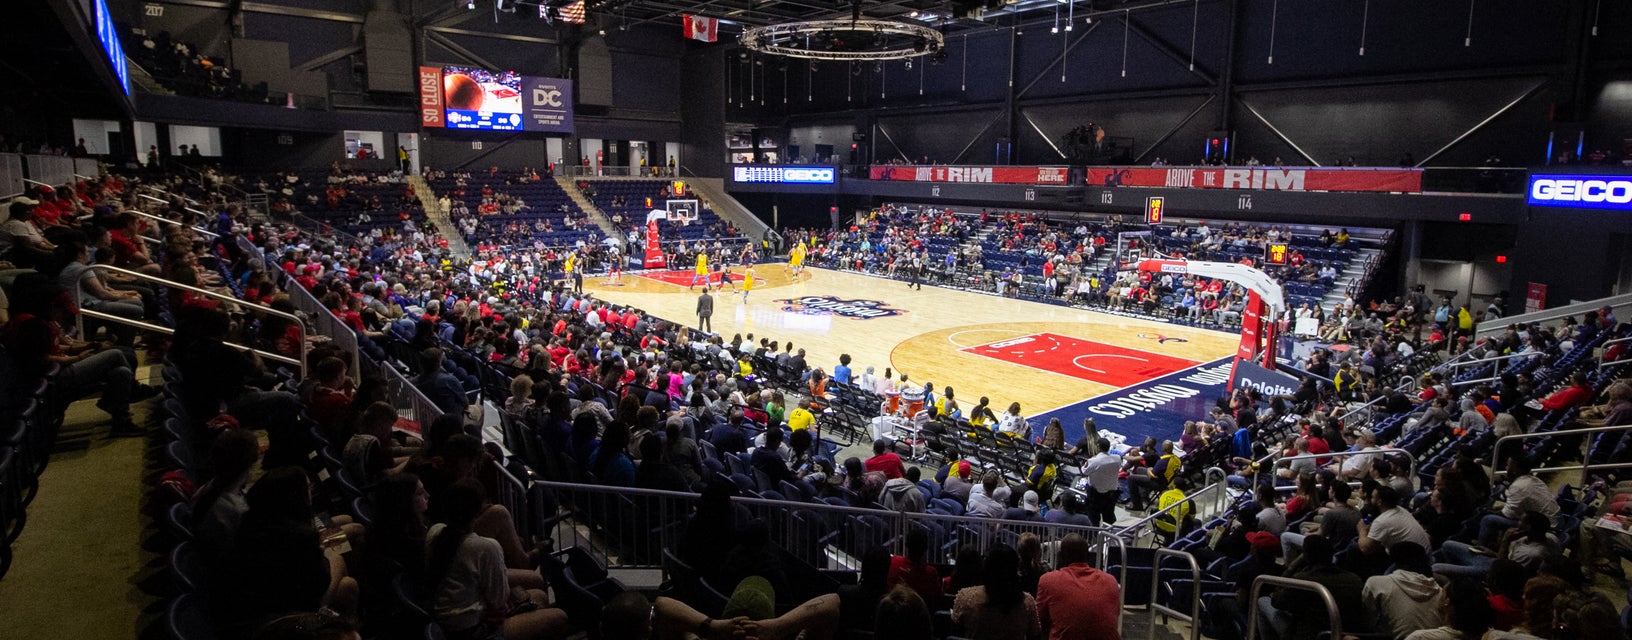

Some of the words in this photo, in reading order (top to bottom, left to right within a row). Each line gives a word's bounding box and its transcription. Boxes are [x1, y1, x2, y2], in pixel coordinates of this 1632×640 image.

[144, 5, 164, 17] 207
[421, 72, 438, 106] CLOSE
[533, 89, 563, 107] DC
[423, 108, 439, 123] SO
[277, 135, 293, 145] 109
[471, 141, 483, 150] 110
[784, 169, 833, 181] GEICO
[948, 167, 993, 183] RIM
[1037, 174, 1065, 182] HERE
[1165, 169, 1195, 187] ABOVE
[1203, 171, 1216, 186] THE
[1223, 169, 1306, 190] RIM
[1025, 191, 1035, 200] 113
[1532, 179, 1632, 203] GEICO
[1101, 193, 1112, 204] 113
[1238, 198, 1252, 210] 114
[1274, 253, 1282, 261] 18
